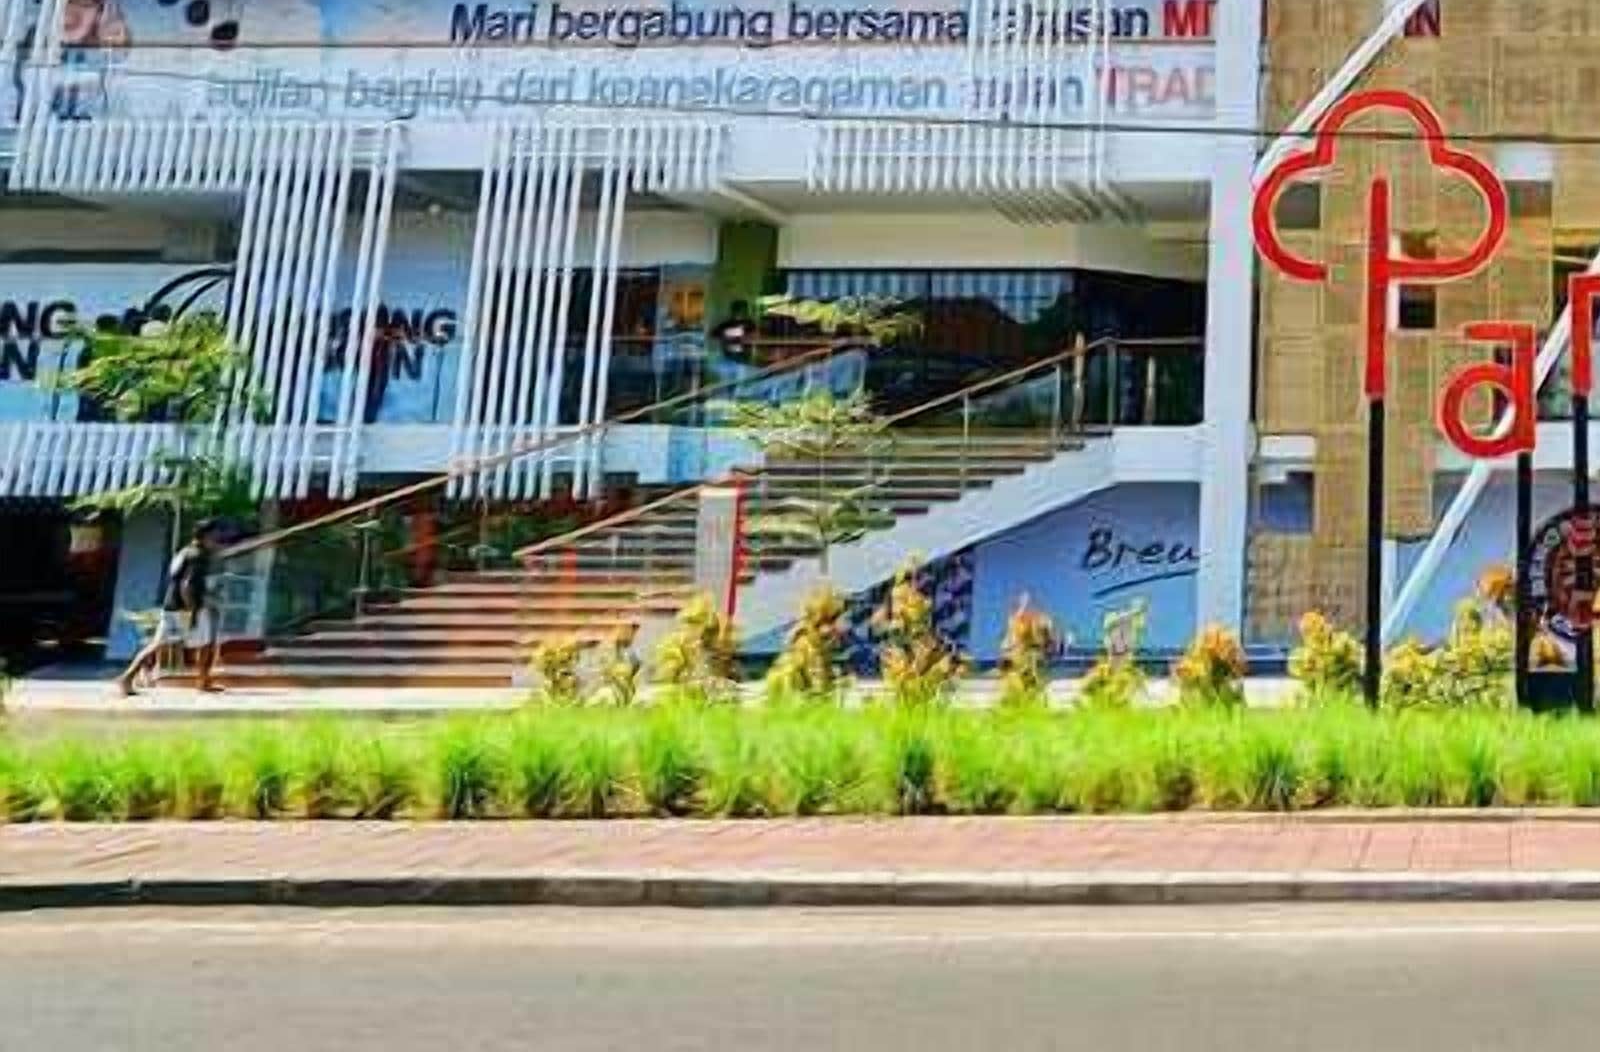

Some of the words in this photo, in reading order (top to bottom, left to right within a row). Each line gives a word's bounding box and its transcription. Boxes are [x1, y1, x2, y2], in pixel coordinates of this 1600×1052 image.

[450, 2, 540, 41] Mari
[548, 0, 774, 49] bergabung
[787, 0, 968, 40] bersama
[498, 67, 577, 106] dari
